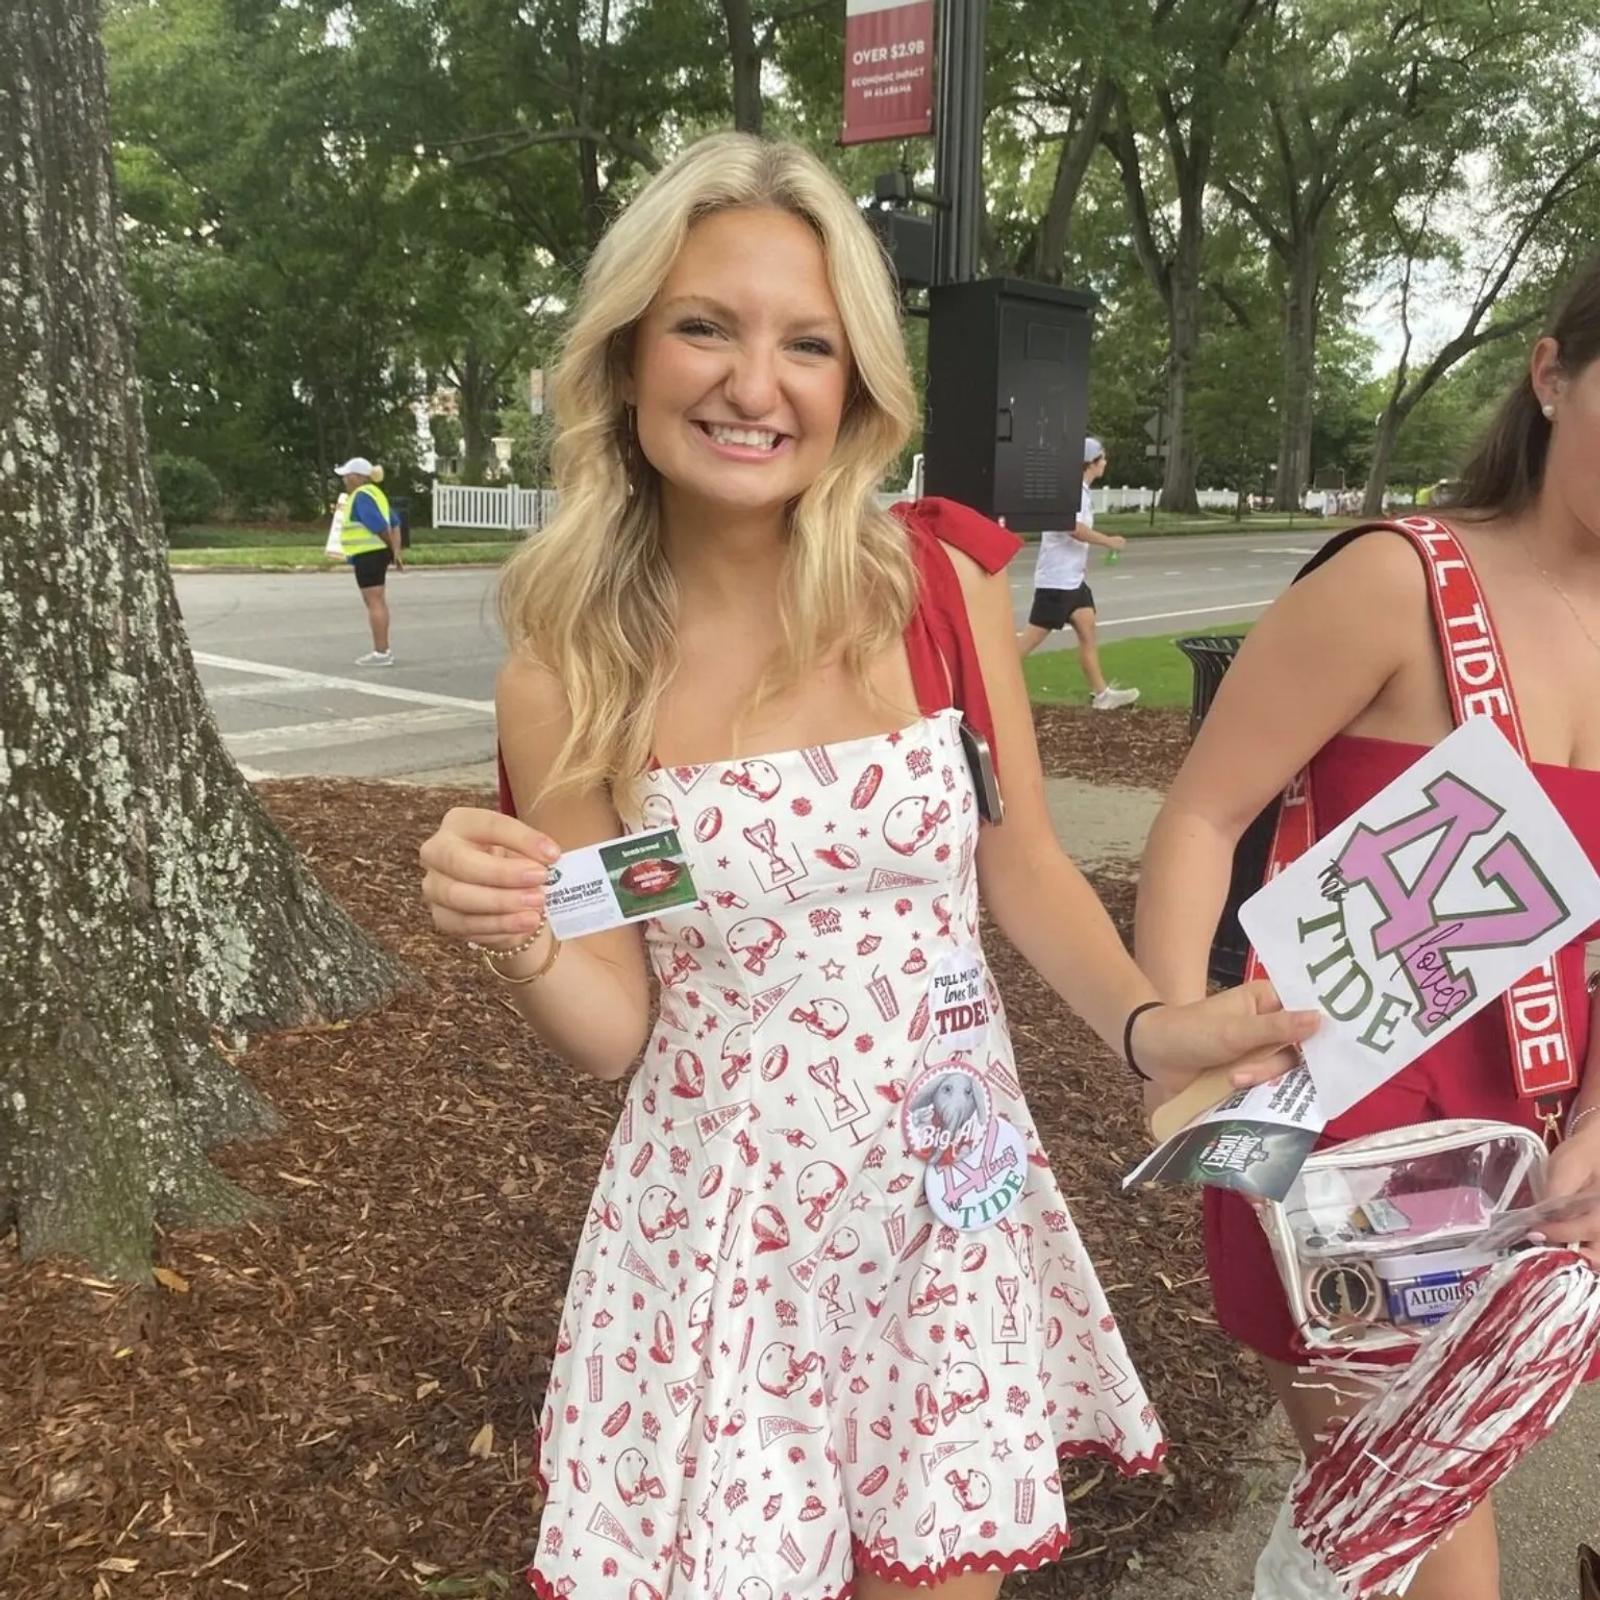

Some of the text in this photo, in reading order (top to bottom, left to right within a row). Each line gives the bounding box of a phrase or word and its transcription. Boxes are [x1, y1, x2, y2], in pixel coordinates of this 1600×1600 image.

[852, 39, 925, 65] OVER $2.9B
[874, 82, 912, 97] ALABAMA
[1395, 516, 1511, 720] OLL TIDE
[934, 974, 958, 988] FULL
[1297, 899, 1413, 1055] TIDE
[1390, 922, 1473, 1023] loves
[934, 998, 989, 1035] TIDE!
[919, 1125, 951, 1151] Big
[1201, 1135, 1243, 1168] TICKET
[958, 1170, 1024, 1229] TIDE
